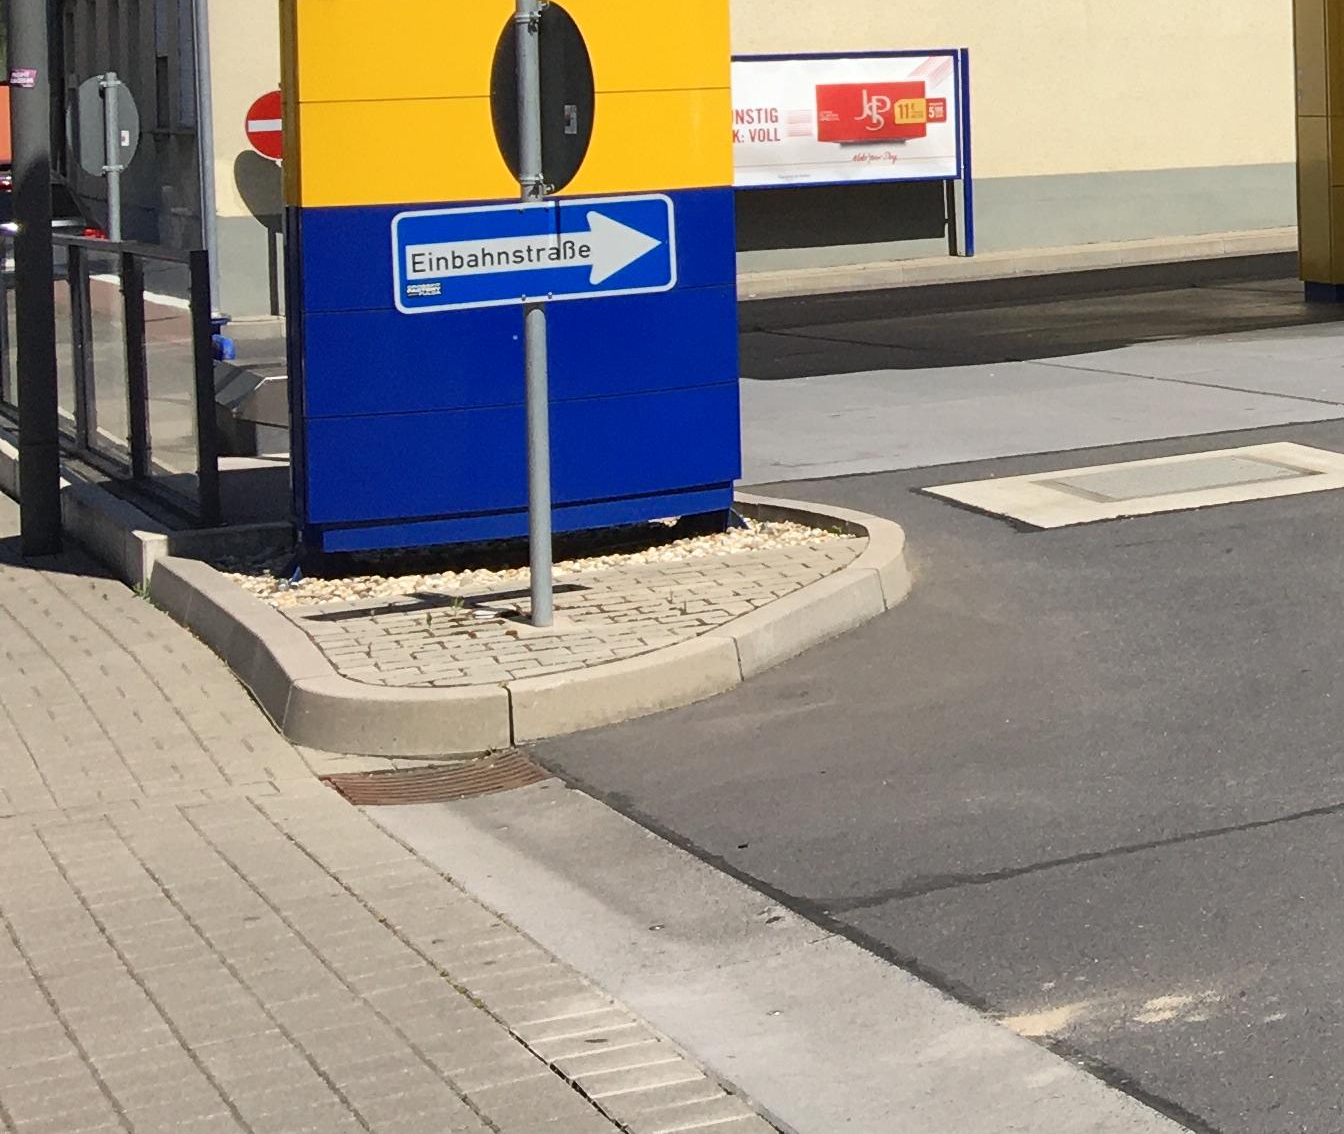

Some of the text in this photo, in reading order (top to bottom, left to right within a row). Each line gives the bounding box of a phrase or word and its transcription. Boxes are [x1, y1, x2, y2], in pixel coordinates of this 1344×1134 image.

[732, 107, 779, 125] NSTIG
[748, 127, 781, 143] VOLL
[410, 239, 591, 274] Einbahnstraße
